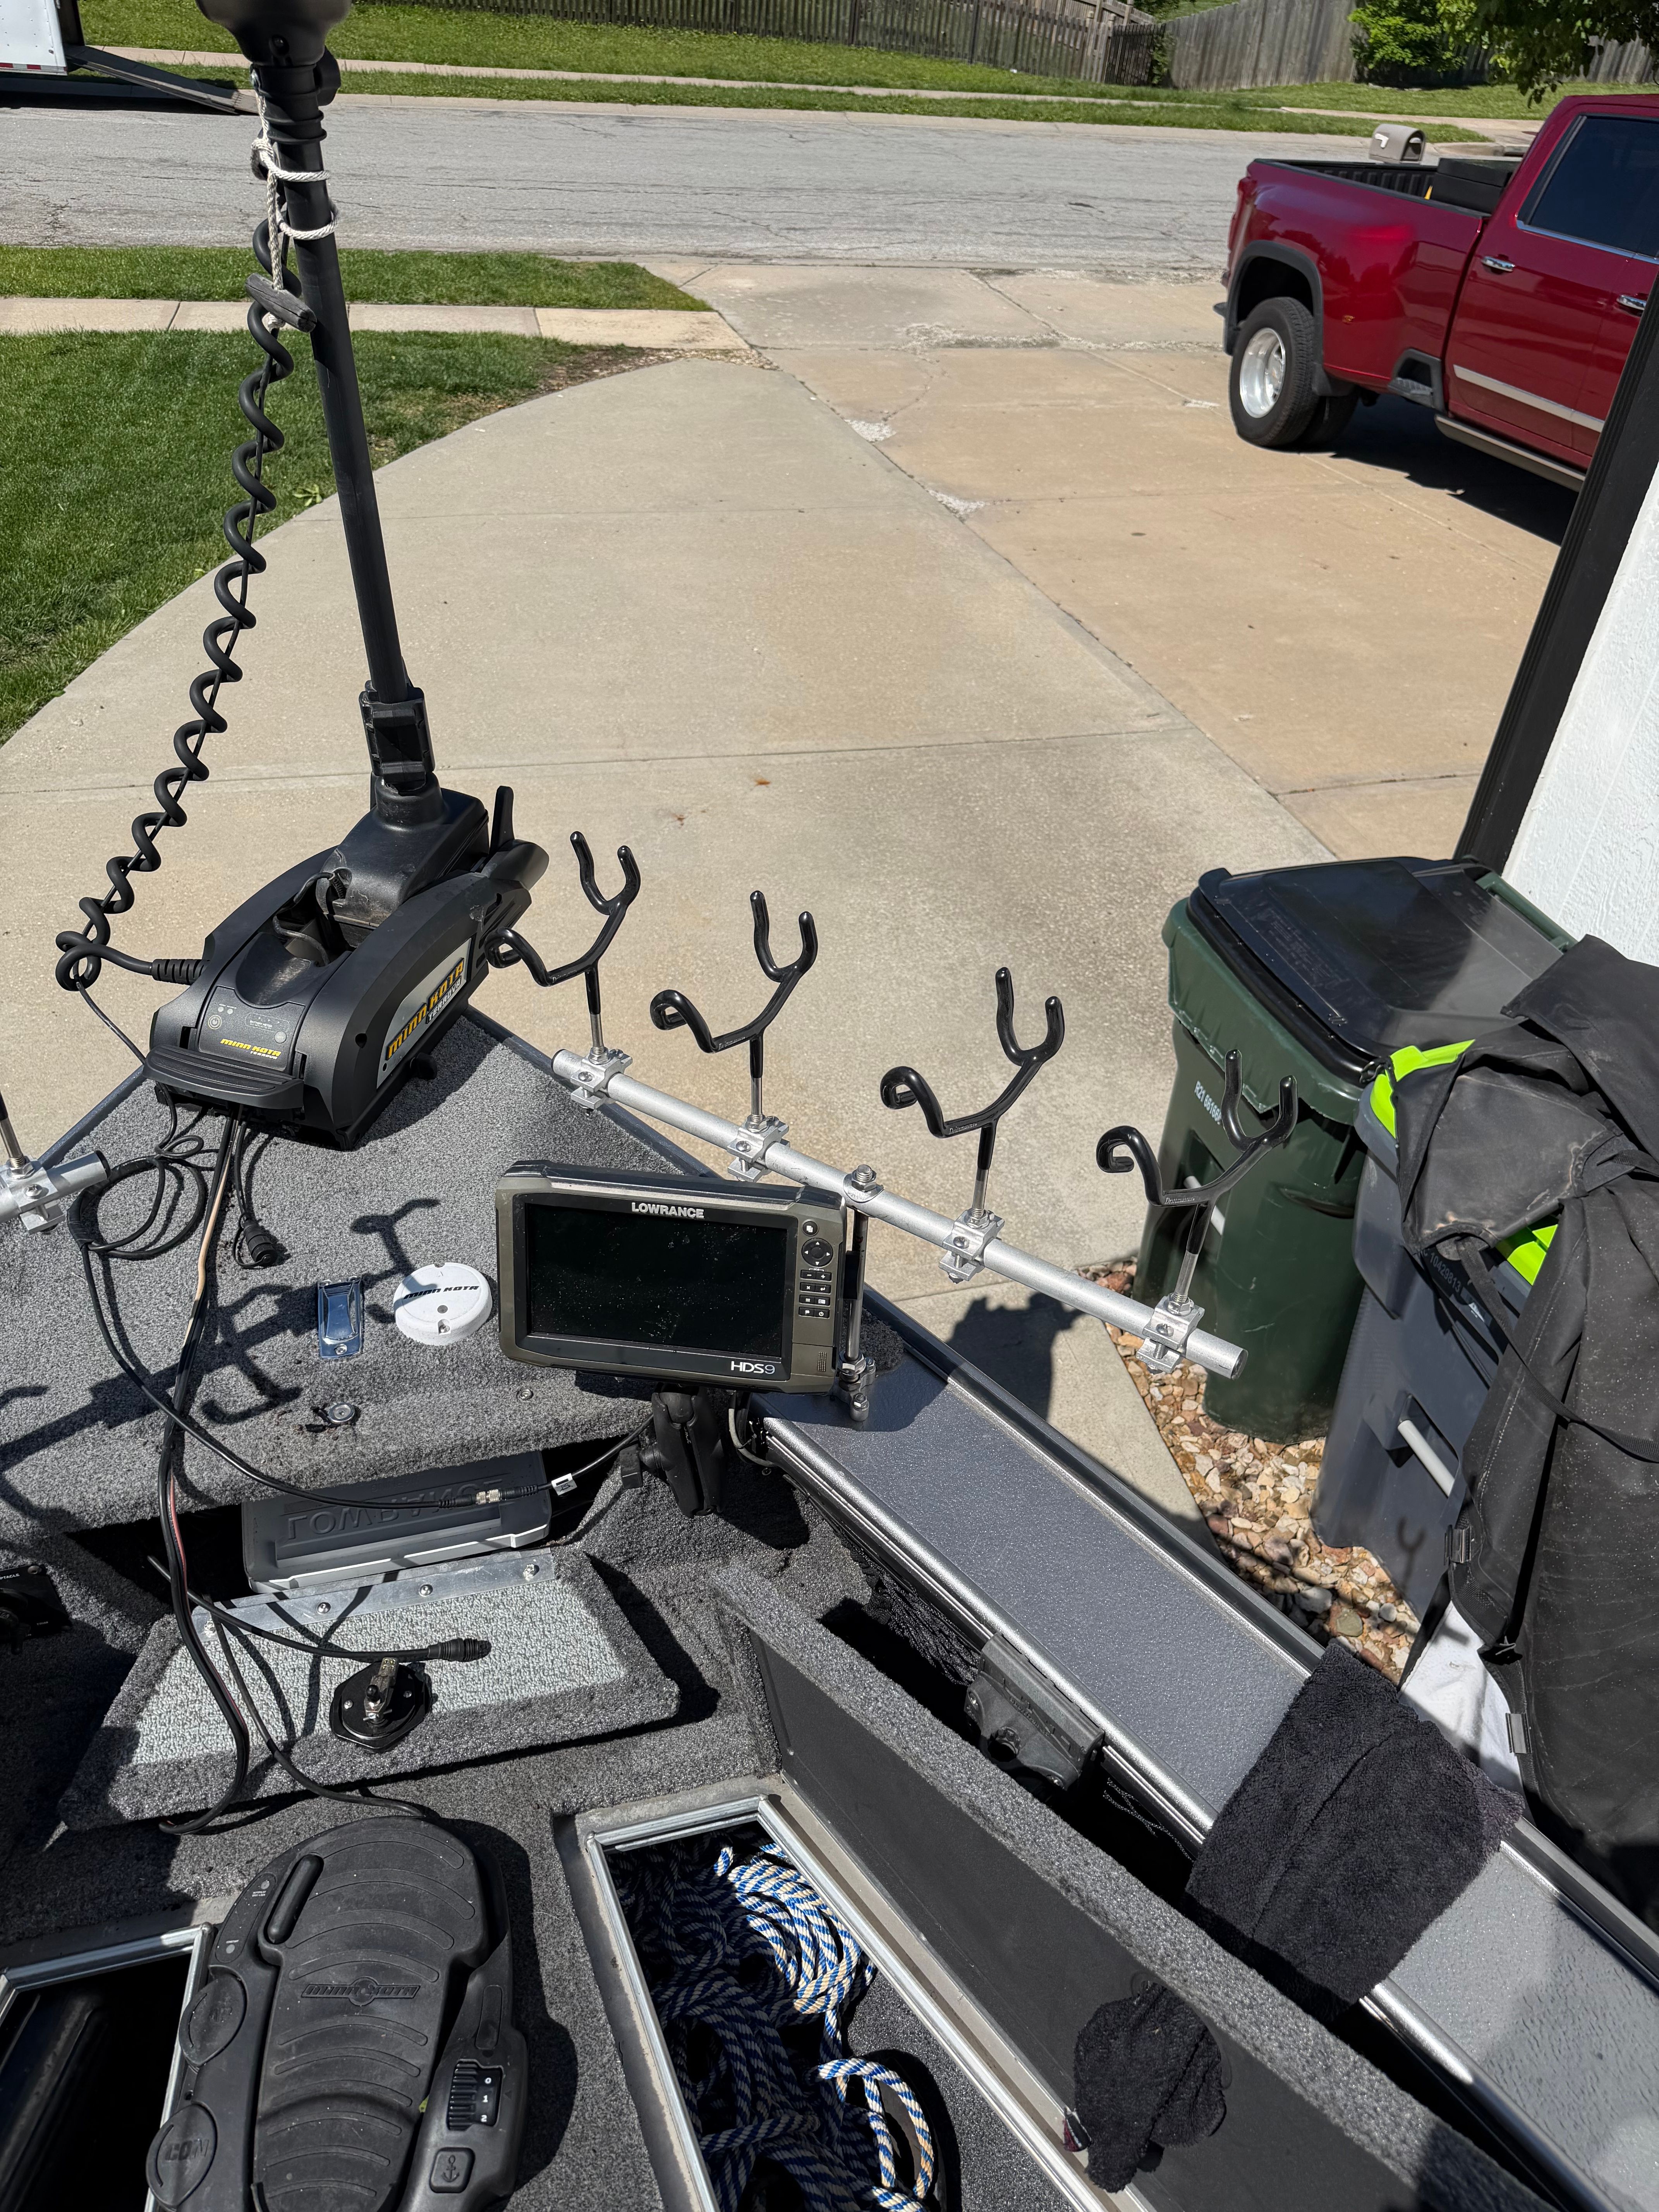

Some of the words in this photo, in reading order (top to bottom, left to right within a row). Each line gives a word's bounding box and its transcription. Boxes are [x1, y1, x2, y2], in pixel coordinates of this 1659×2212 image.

[428, 976, 461, 1022] TERROVA
[632, 1202, 704, 1219] LOWRANCE
[1430, 1252, 1461, 1293] 10429813
[731, 1361, 775, 1374] HDS9
